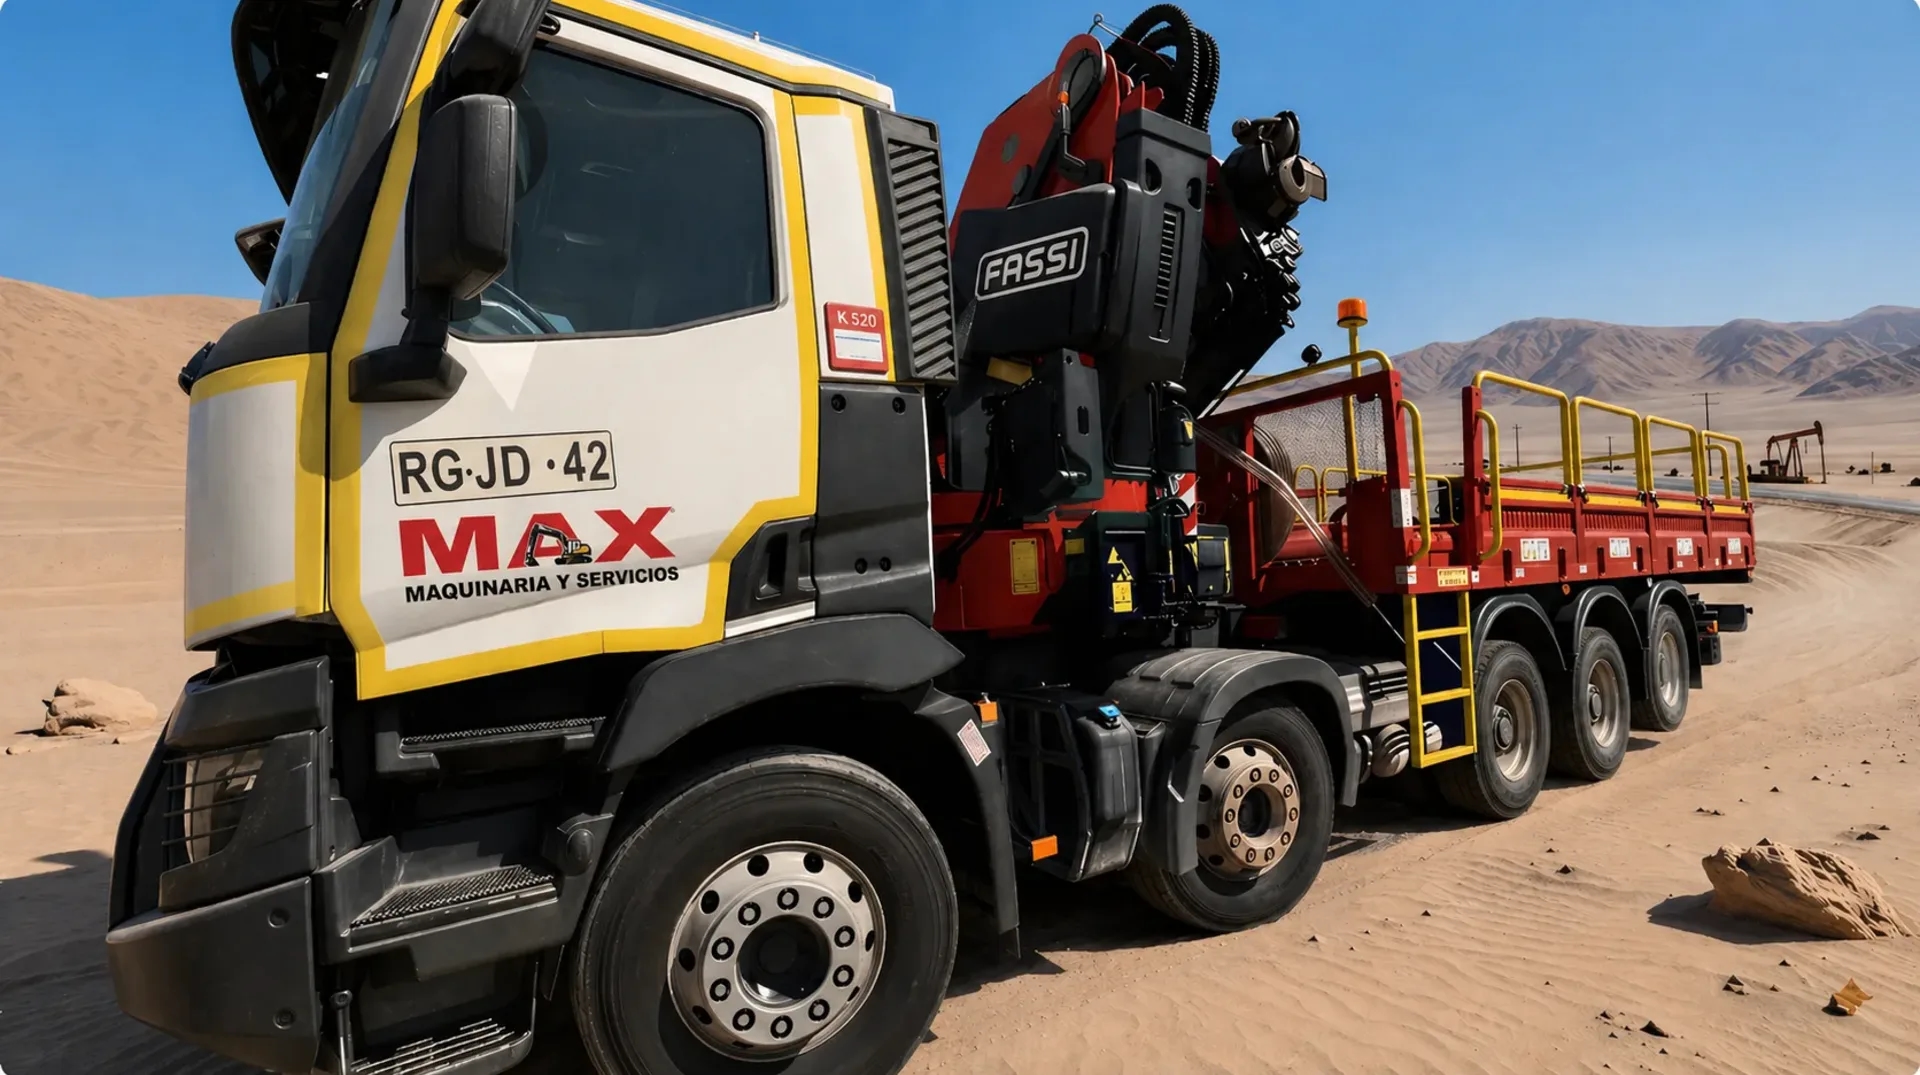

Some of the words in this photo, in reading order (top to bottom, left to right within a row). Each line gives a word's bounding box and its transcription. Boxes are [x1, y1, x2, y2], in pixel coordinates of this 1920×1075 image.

[983, 238, 1079, 291] FASSI
[836, 310, 849, 325] K
[851, 312, 877, 328] 520
[398, 506, 676, 577] MAX
[405, 575, 551, 603] MAQUINARIA
[556, 574, 570, 590] Y
[577, 566, 679, 588] SERVICIOS
